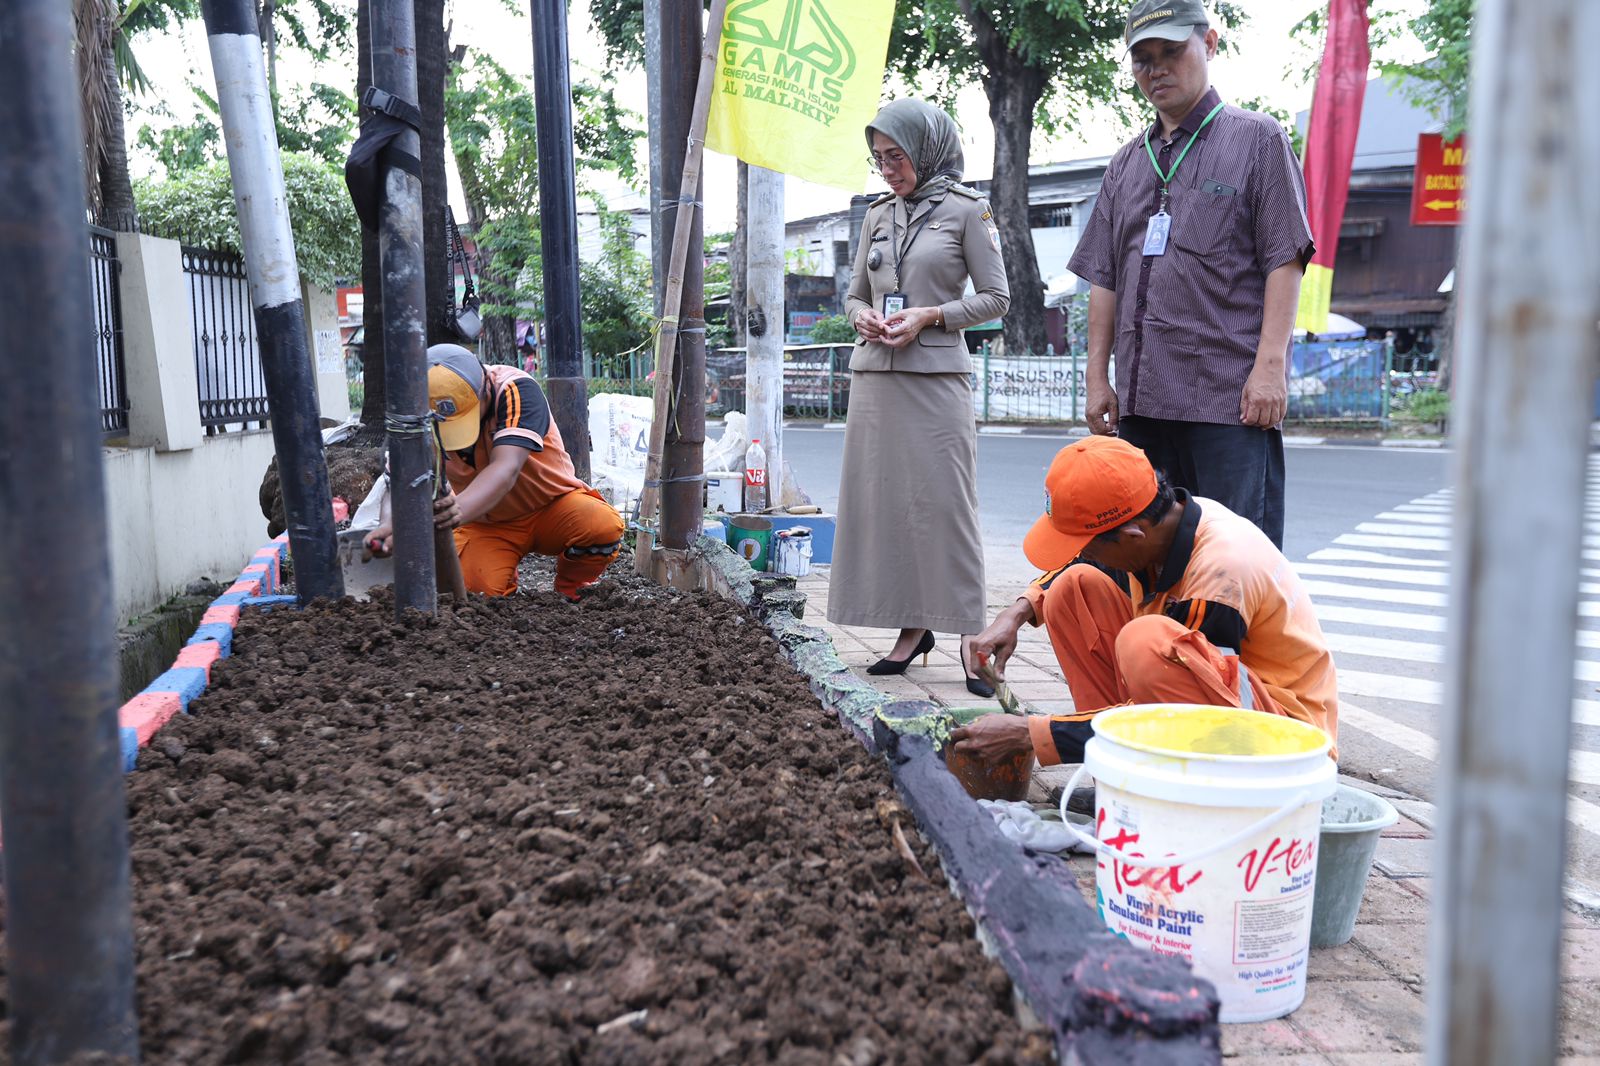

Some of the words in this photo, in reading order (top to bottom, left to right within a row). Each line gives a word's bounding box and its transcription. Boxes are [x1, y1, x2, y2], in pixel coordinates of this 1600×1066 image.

[722, 67, 770, 84] GENERASI
[772, 77, 806, 98] MUDA
[807, 91, 840, 114] ISLAM
[723, 41, 844, 103] GAMIS
[722, 80, 738, 96] AL
[743, 83, 836, 128] MALIKIY
[1109, 898, 1153, 928] Emulsion
[1158, 918, 1192, 936] Paint
[1126, 894, 1154, 915] Vinyl
[1158, 904, 1204, 924] Acrylic
[1163, 936, 1192, 950] Interior
